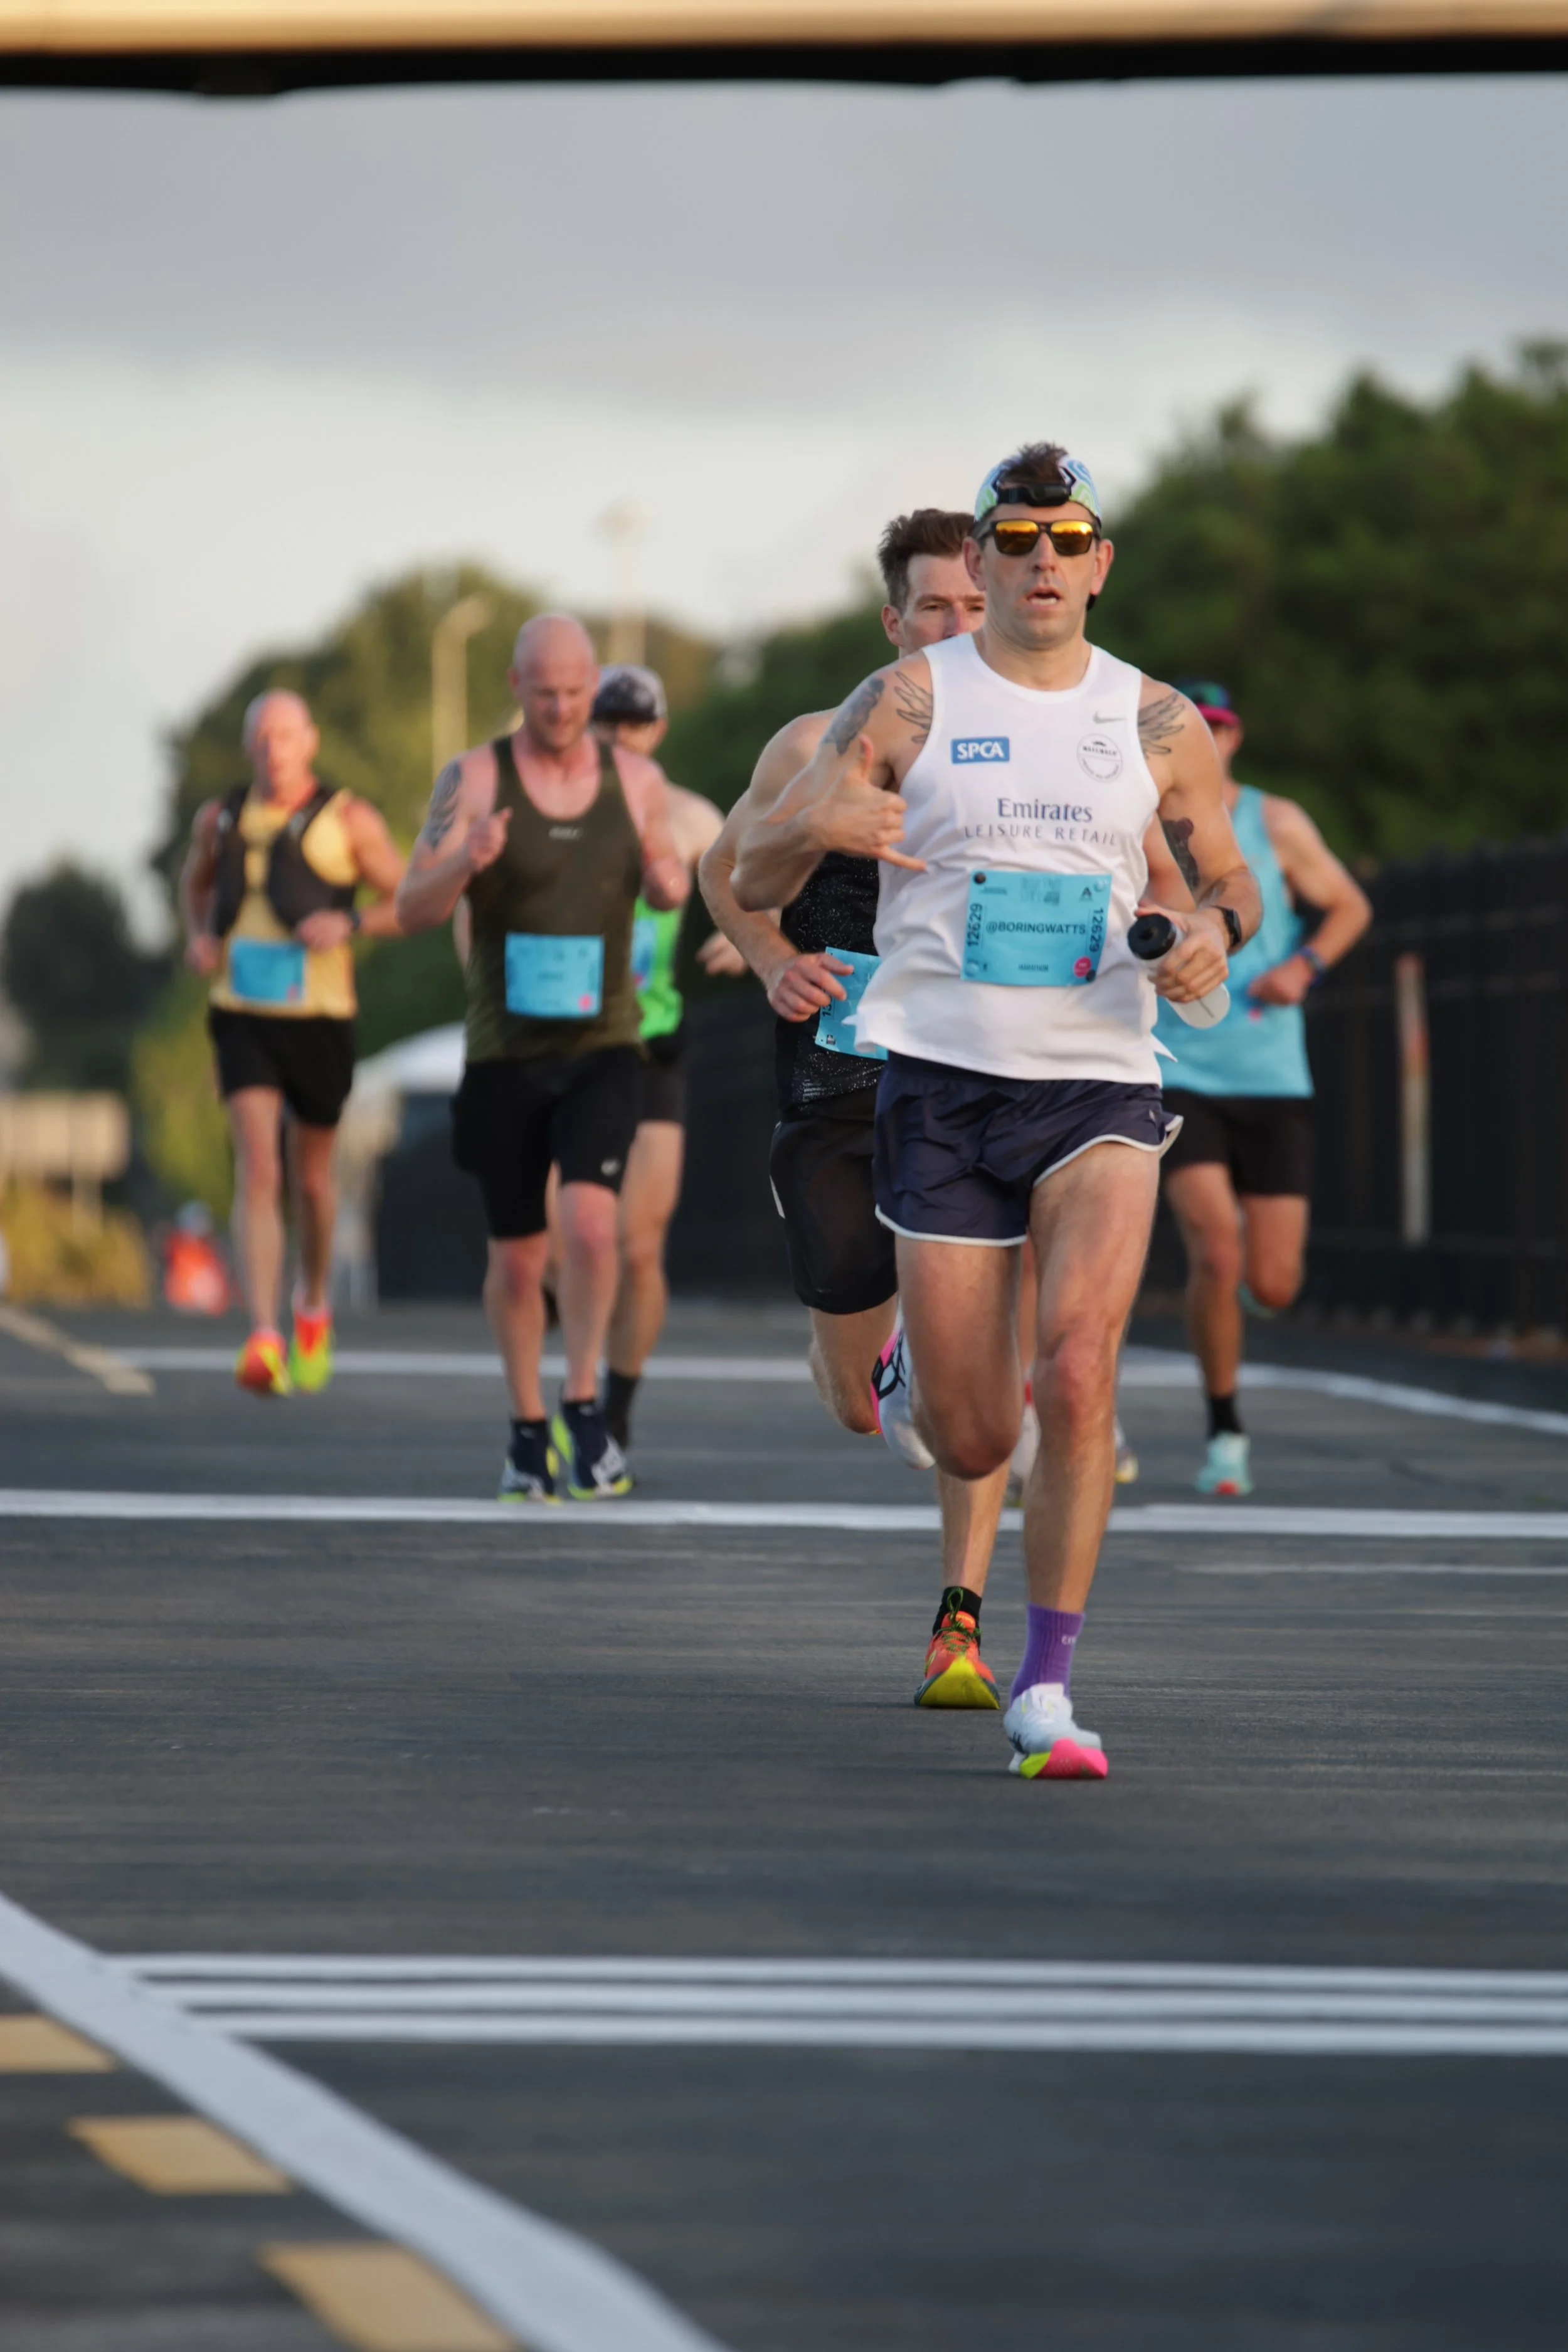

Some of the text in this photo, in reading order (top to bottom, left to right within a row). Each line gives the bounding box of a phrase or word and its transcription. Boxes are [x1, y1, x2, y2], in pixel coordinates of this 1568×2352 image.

[957, 741, 1004, 760] SPCA
[997, 797, 1093, 823] Emirates
[965, 824, 1116, 846] LEISURE RETAIL
[967, 903, 983, 947] 12629
[985, 921, 1086, 935] @BORINGWATTS
[1089, 908, 1103, 953] 12629
